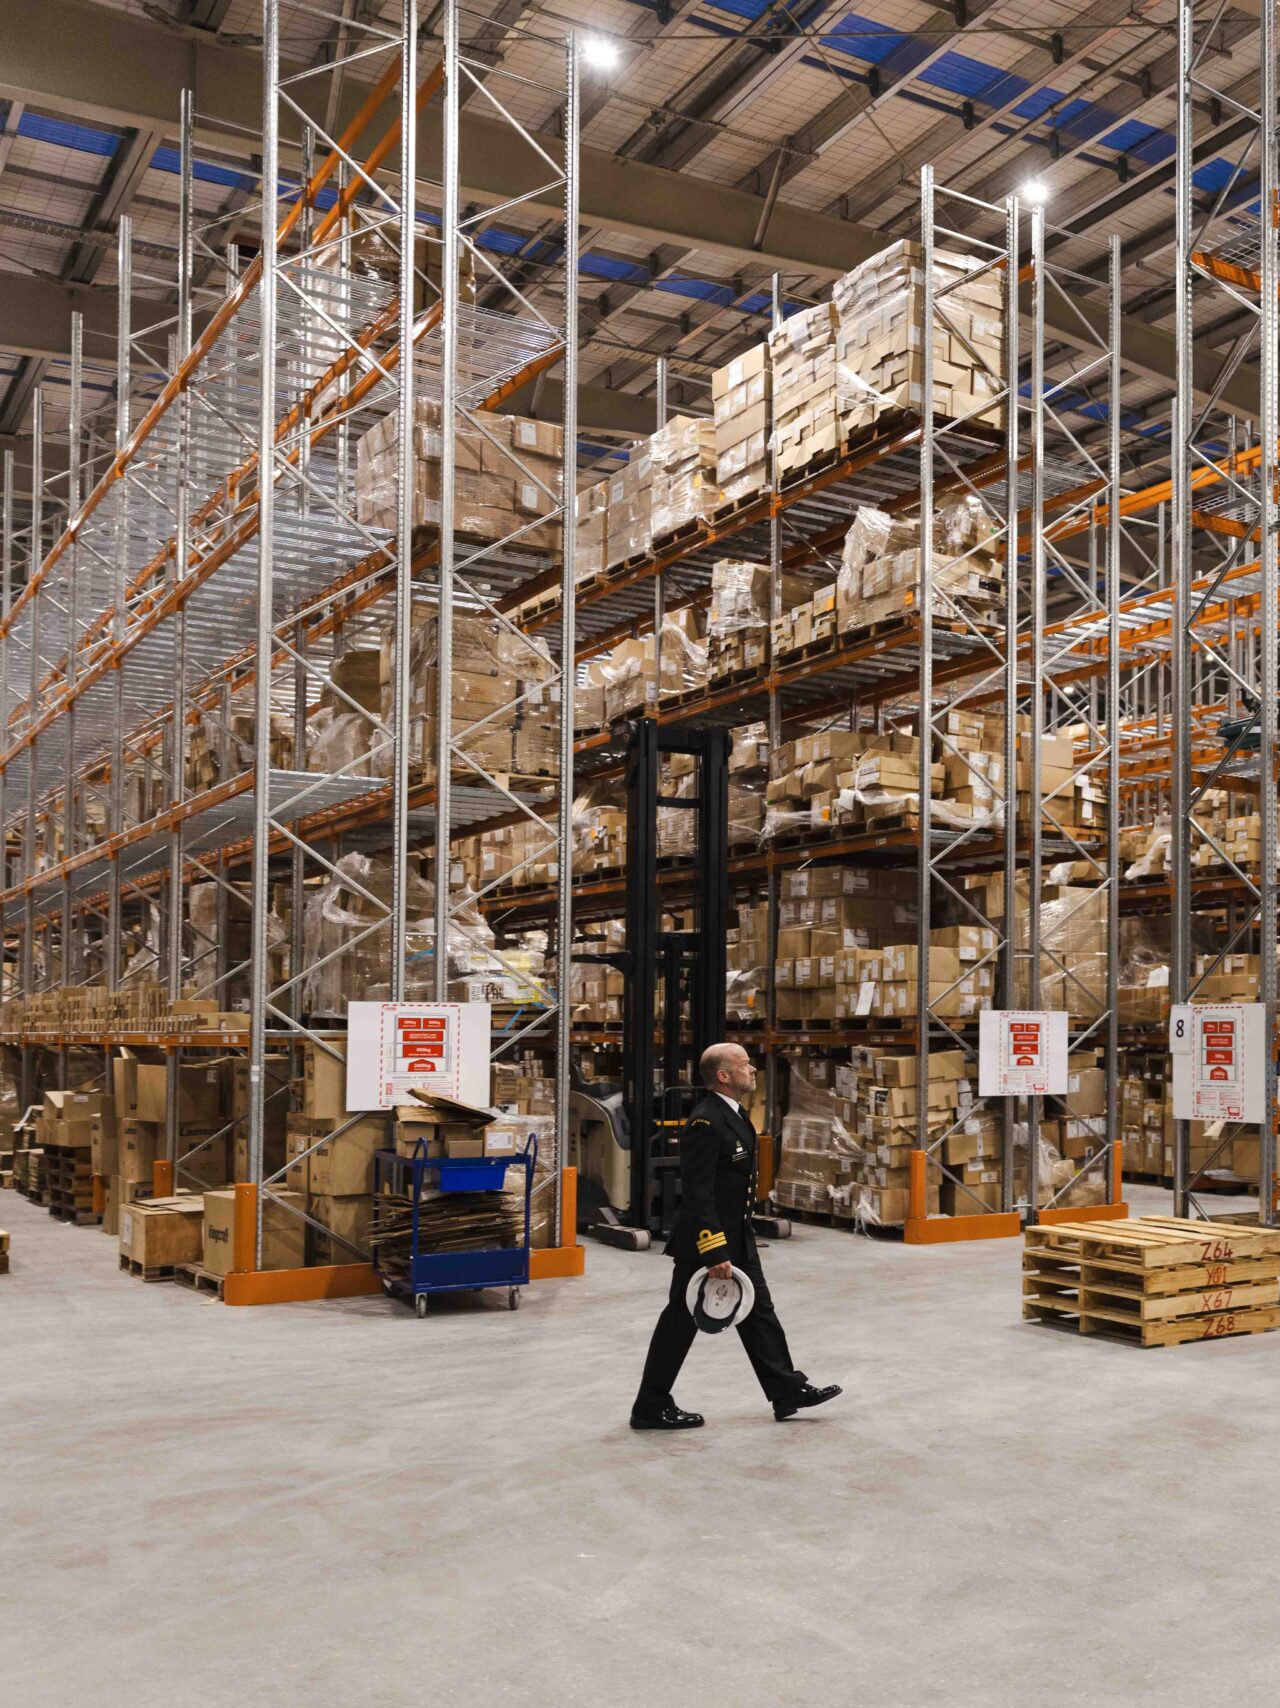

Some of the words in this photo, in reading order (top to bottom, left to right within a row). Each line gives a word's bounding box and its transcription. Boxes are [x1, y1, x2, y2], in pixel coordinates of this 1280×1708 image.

[1175, 1019, 1185, 1038] 8
[1199, 1241, 1234, 1261] Z64
[1201, 1290, 1233, 1312] X67
[1202, 1316, 1235, 1338] Z68
